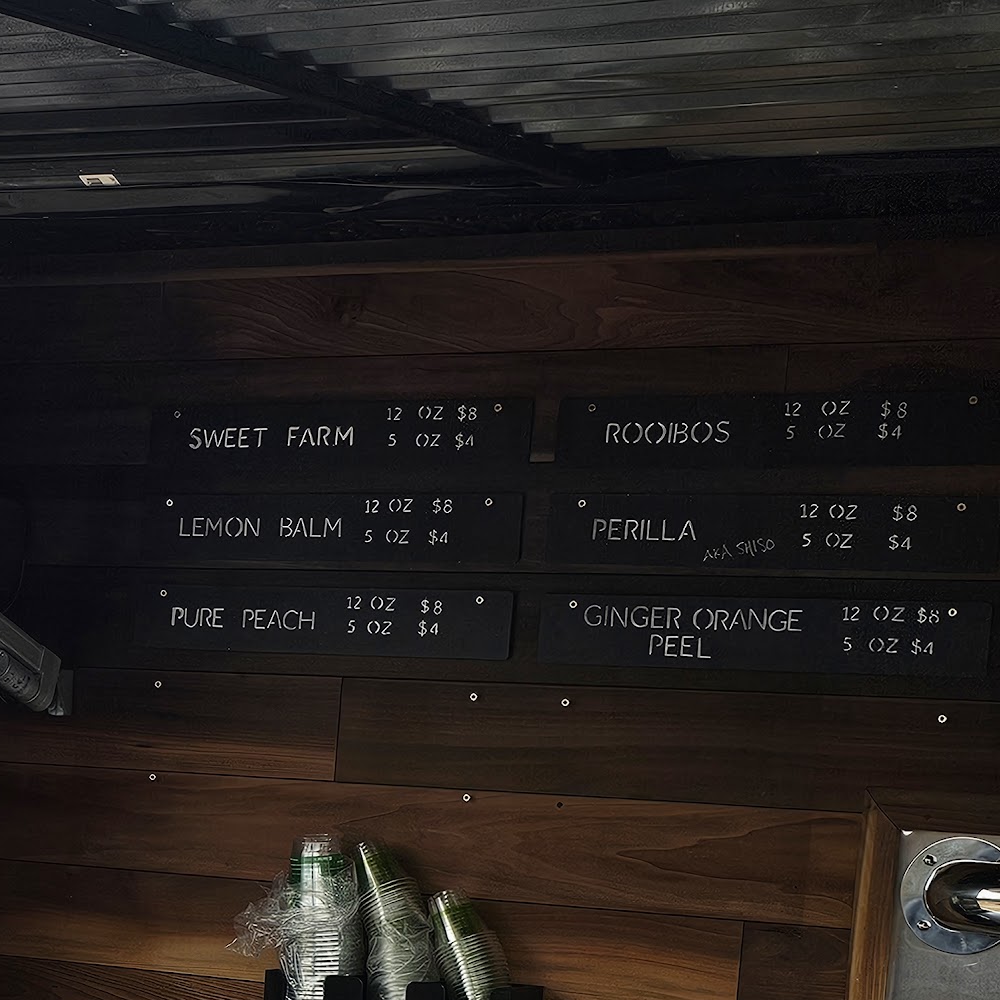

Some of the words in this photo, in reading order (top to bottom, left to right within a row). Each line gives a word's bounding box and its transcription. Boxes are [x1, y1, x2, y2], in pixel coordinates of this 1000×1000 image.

[386, 406, 403, 421] 12
[418, 405, 444, 421] OZ
[457, 404, 478, 423] $8
[784, 402, 802, 417] 12
[821, 400, 851, 417] OZ
[880, 399, 908, 420] $8
[188, 427, 269, 450] SWEET
[286, 425, 354, 448] FARM
[605, 420, 730, 445] ROOIBOS
[786, 425, 796, 440] 5
[818, 423, 846, 439] OZ
[877, 422, 901, 440] $4
[387, 433, 397, 447] 5
[415, 433, 441, 448] OZ
[454, 431, 474, 451] $4
[364, 499, 380, 514] 12
[388, 498, 414, 513] OZ
[432, 497, 453, 514] $8
[799, 503, 819, 519] 12
[828, 503, 858, 521] OZ
[892, 503, 918, 522] $8
[178, 516, 261, 538] LEMON
[279, 517, 342, 538] BALM
[592, 518, 697, 542] PERILLA
[364, 529, 373, 543] 5
[385, 529, 410, 545] OZ
[428, 529, 448, 546] $4
[801, 532, 812, 548] 5
[825, 532, 854, 549] OZ
[888, 534, 912, 551] $4
[735, 538, 776, 557] SHISO
[346, 595, 362, 610] 12
[370, 595, 397, 612] OZ
[420, 598, 443, 616] $8
[842, 606, 861, 622] 12
[872, 605, 906, 623] OZ
[916, 606, 940, 624] $8
[171, 606, 225, 629] PURE
[242, 608, 316, 631] PEACH
[583, 604, 682, 630] GINGER
[692, 607, 804, 632] ORANGE
[347, 619, 356, 634] 5
[366, 620, 393, 636] OZ
[417, 619, 439, 638] $4
[648, 633, 712, 659] PEEL
[843, 636, 853, 652] 5
[868, 637, 899, 654] OZ
[910, 637, 934, 655] $4
